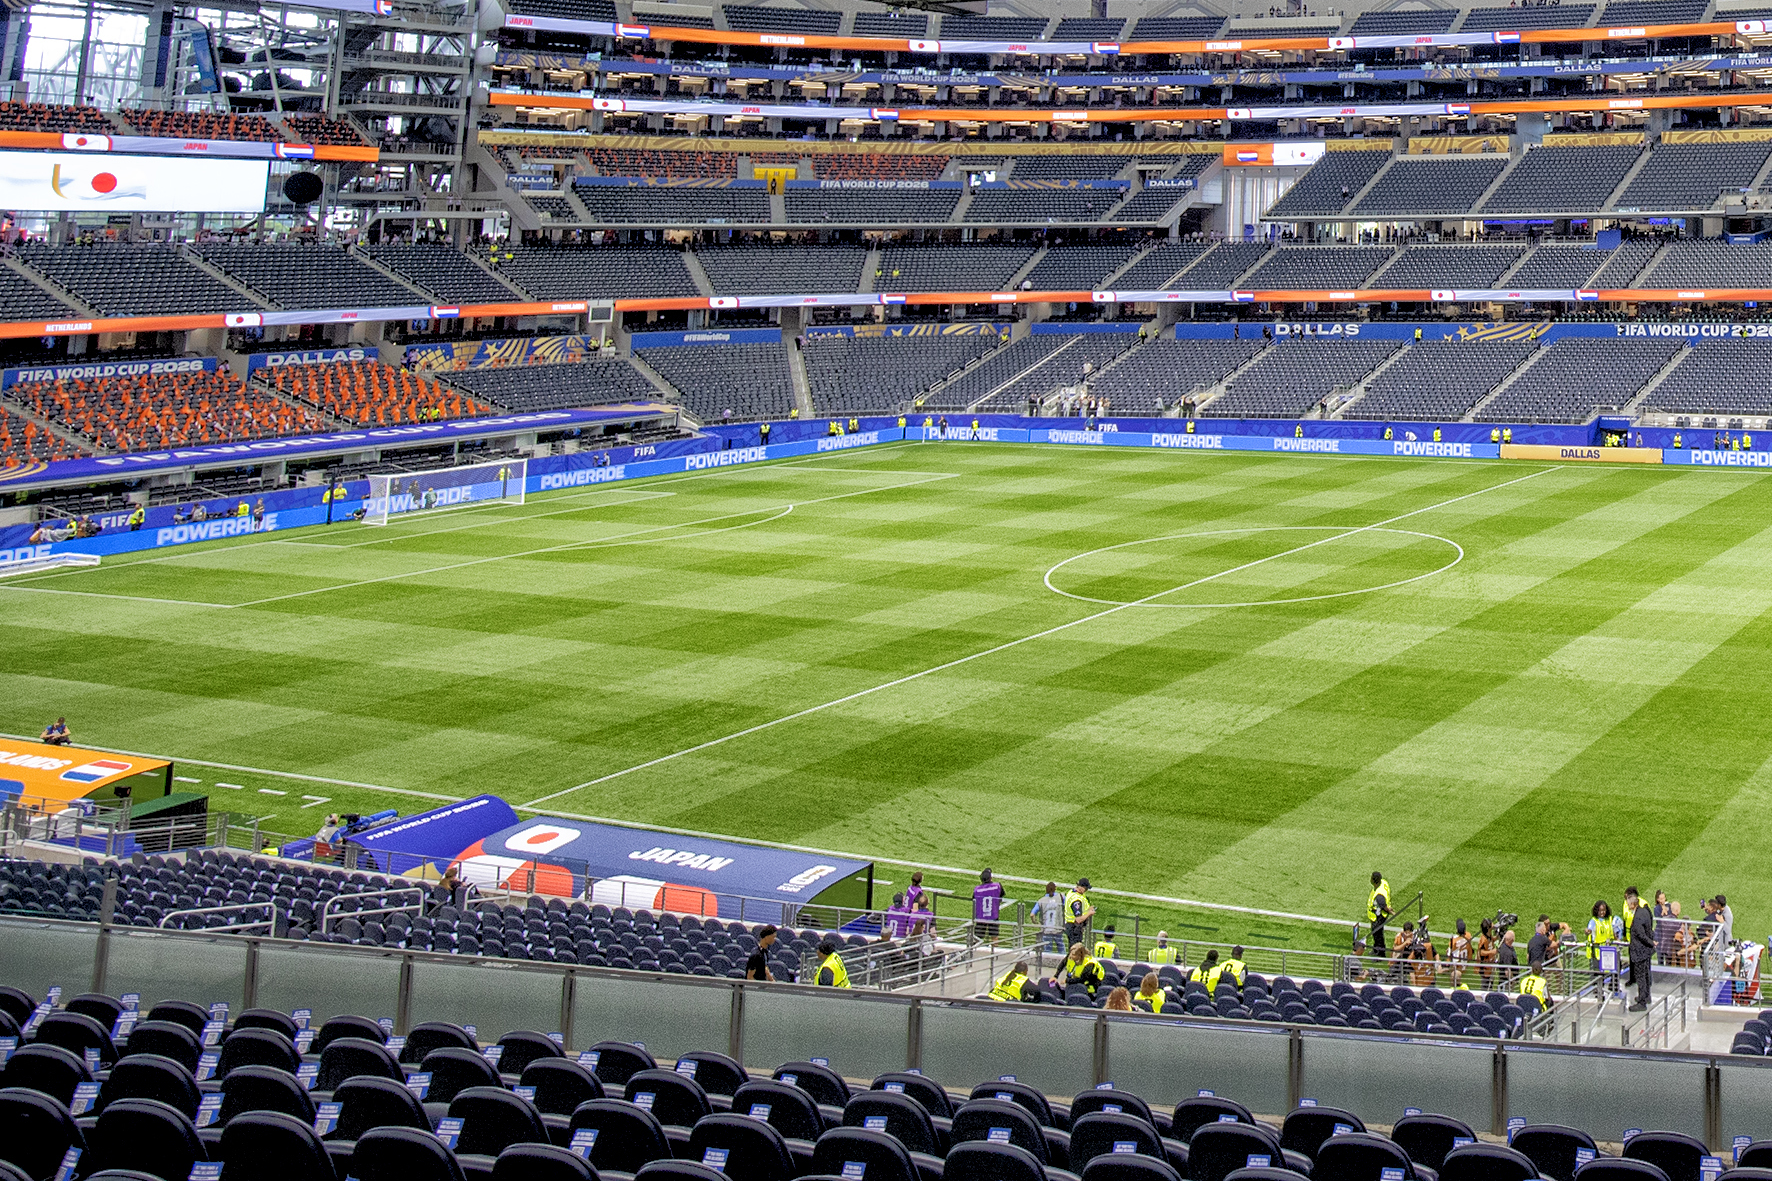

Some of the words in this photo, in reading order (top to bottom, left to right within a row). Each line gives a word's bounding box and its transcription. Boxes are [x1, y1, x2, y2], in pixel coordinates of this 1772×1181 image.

[509, 17, 533, 26] JAPAN
[1415, 36, 1433, 44] JAPAN
[671, 64, 730, 76] DALLAS
[1554, 64, 1602, 73] DALLAS
[1112, 76, 1158, 84] DALLAS
[183, 142, 208, 151] JAPAN
[509, 176, 553, 184] DALLAS
[820, 180, 841, 188] FIFA
[841, 180, 876, 188] WORLD
[877, 180, 896, 188] CUP
[896, 180, 929, 188] 2026
[1149, 179, 1193, 187] DALLAS
[45, 322, 92, 332] NETHERLANDS
[1275, 324, 1360, 336] DALLAS
[1617, 325, 1647, 336] FIFA
[1647, 325, 1699, 337] WORLD
[1701, 325, 1729, 337] CUP
[683, 332, 731, 343] #FIFAWorldCup
[266, 349, 365, 367] DALLAS
[18, 368, 53, 382] FIFA
[53, 365, 117, 379] WORLD
[118, 363, 150, 375] CUP
[151, 359, 204, 374] 2026
[1098, 423, 1118, 432] FIFA
[96, 450, 212, 466] FIFA
[203, 433, 366, 454] WORLD
[369, 425, 444, 437] CUP
[448, 412, 572, 429] 2026
[817, 431, 880, 451] POWERADE
[1152, 434, 1223, 449] POWERADE
[634, 445, 656, 458] FIFA
[1274, 438, 1339, 453] POWERADE
[1393, 441, 1472, 457] POWERADE
[685, 447, 768, 471] POWERADE
[1560, 448, 1601, 460] DALLAS
[540, 465, 625, 490] POWERADE
[628, 846, 735, 872] JAPAN
